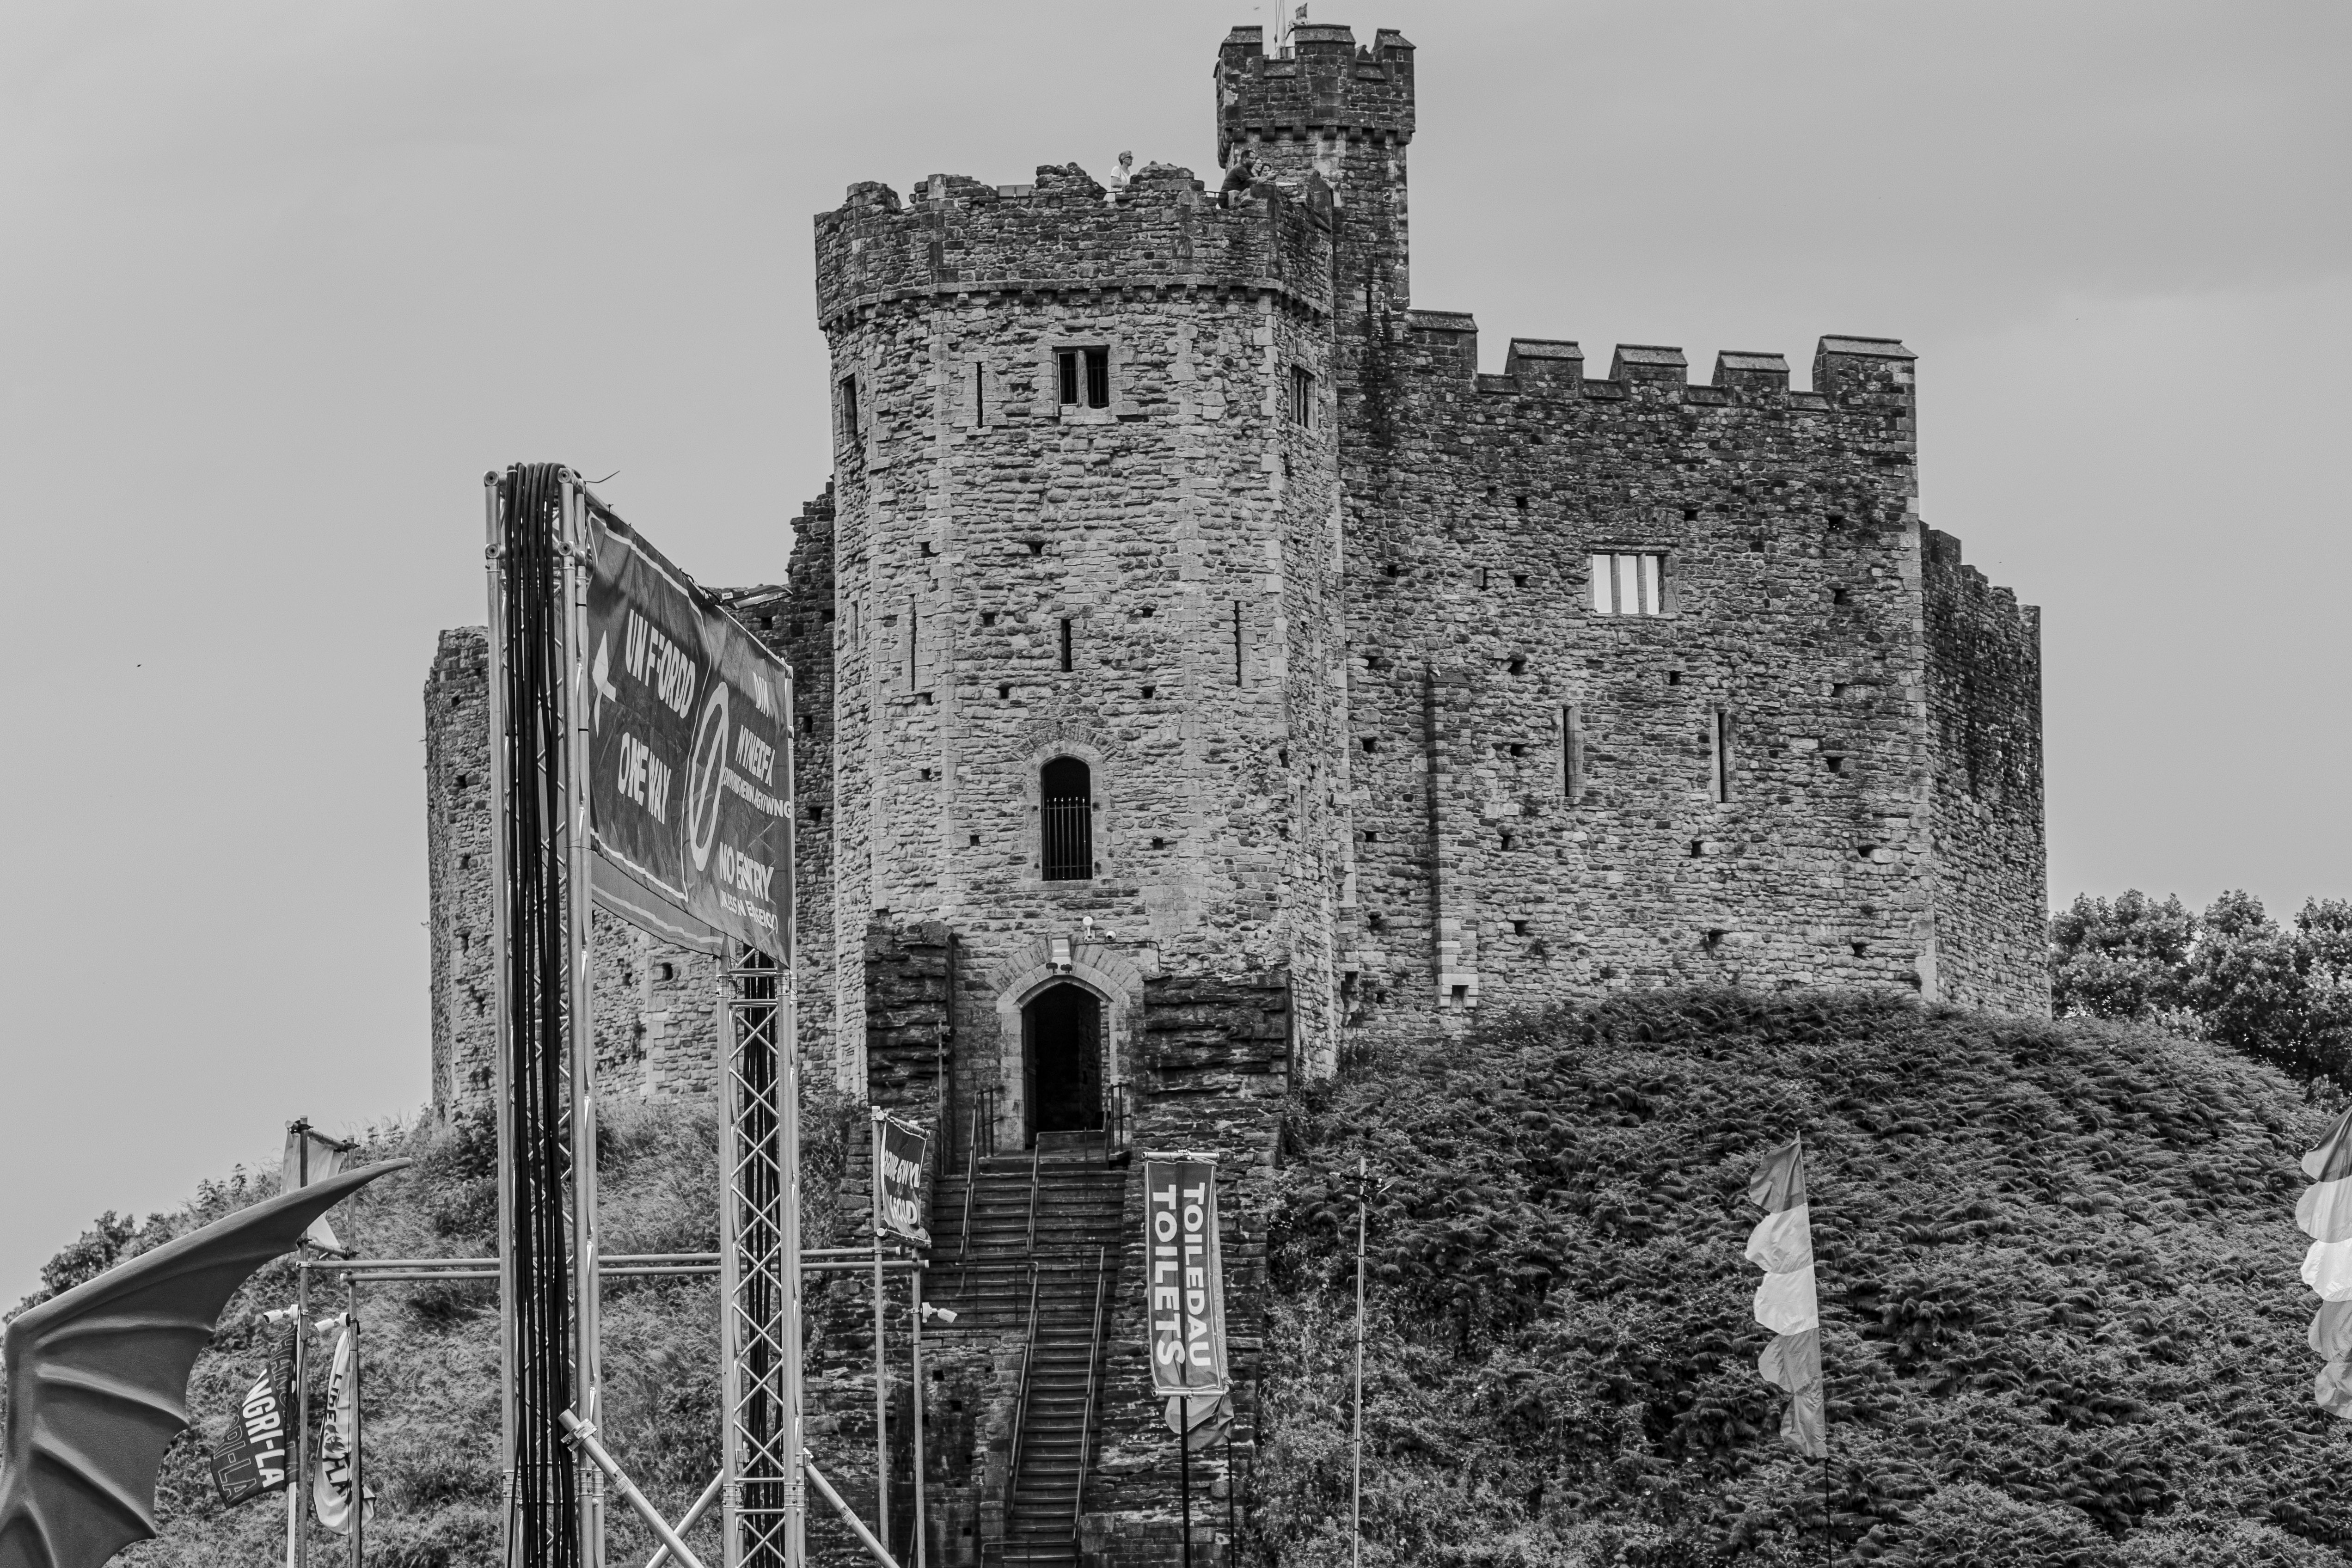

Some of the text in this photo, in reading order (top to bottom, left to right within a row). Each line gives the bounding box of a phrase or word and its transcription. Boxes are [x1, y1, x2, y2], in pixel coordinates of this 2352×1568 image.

[625, 609, 648, 681] UN
[753, 672, 769, 717] DIM
[618, 732, 672, 825] ONE WAY
[719, 841, 774, 902] NO ENTRY
[1152, 1184, 1186, 1365] TOILETS
[1183, 1182, 1212, 1366] TOILEDAU
